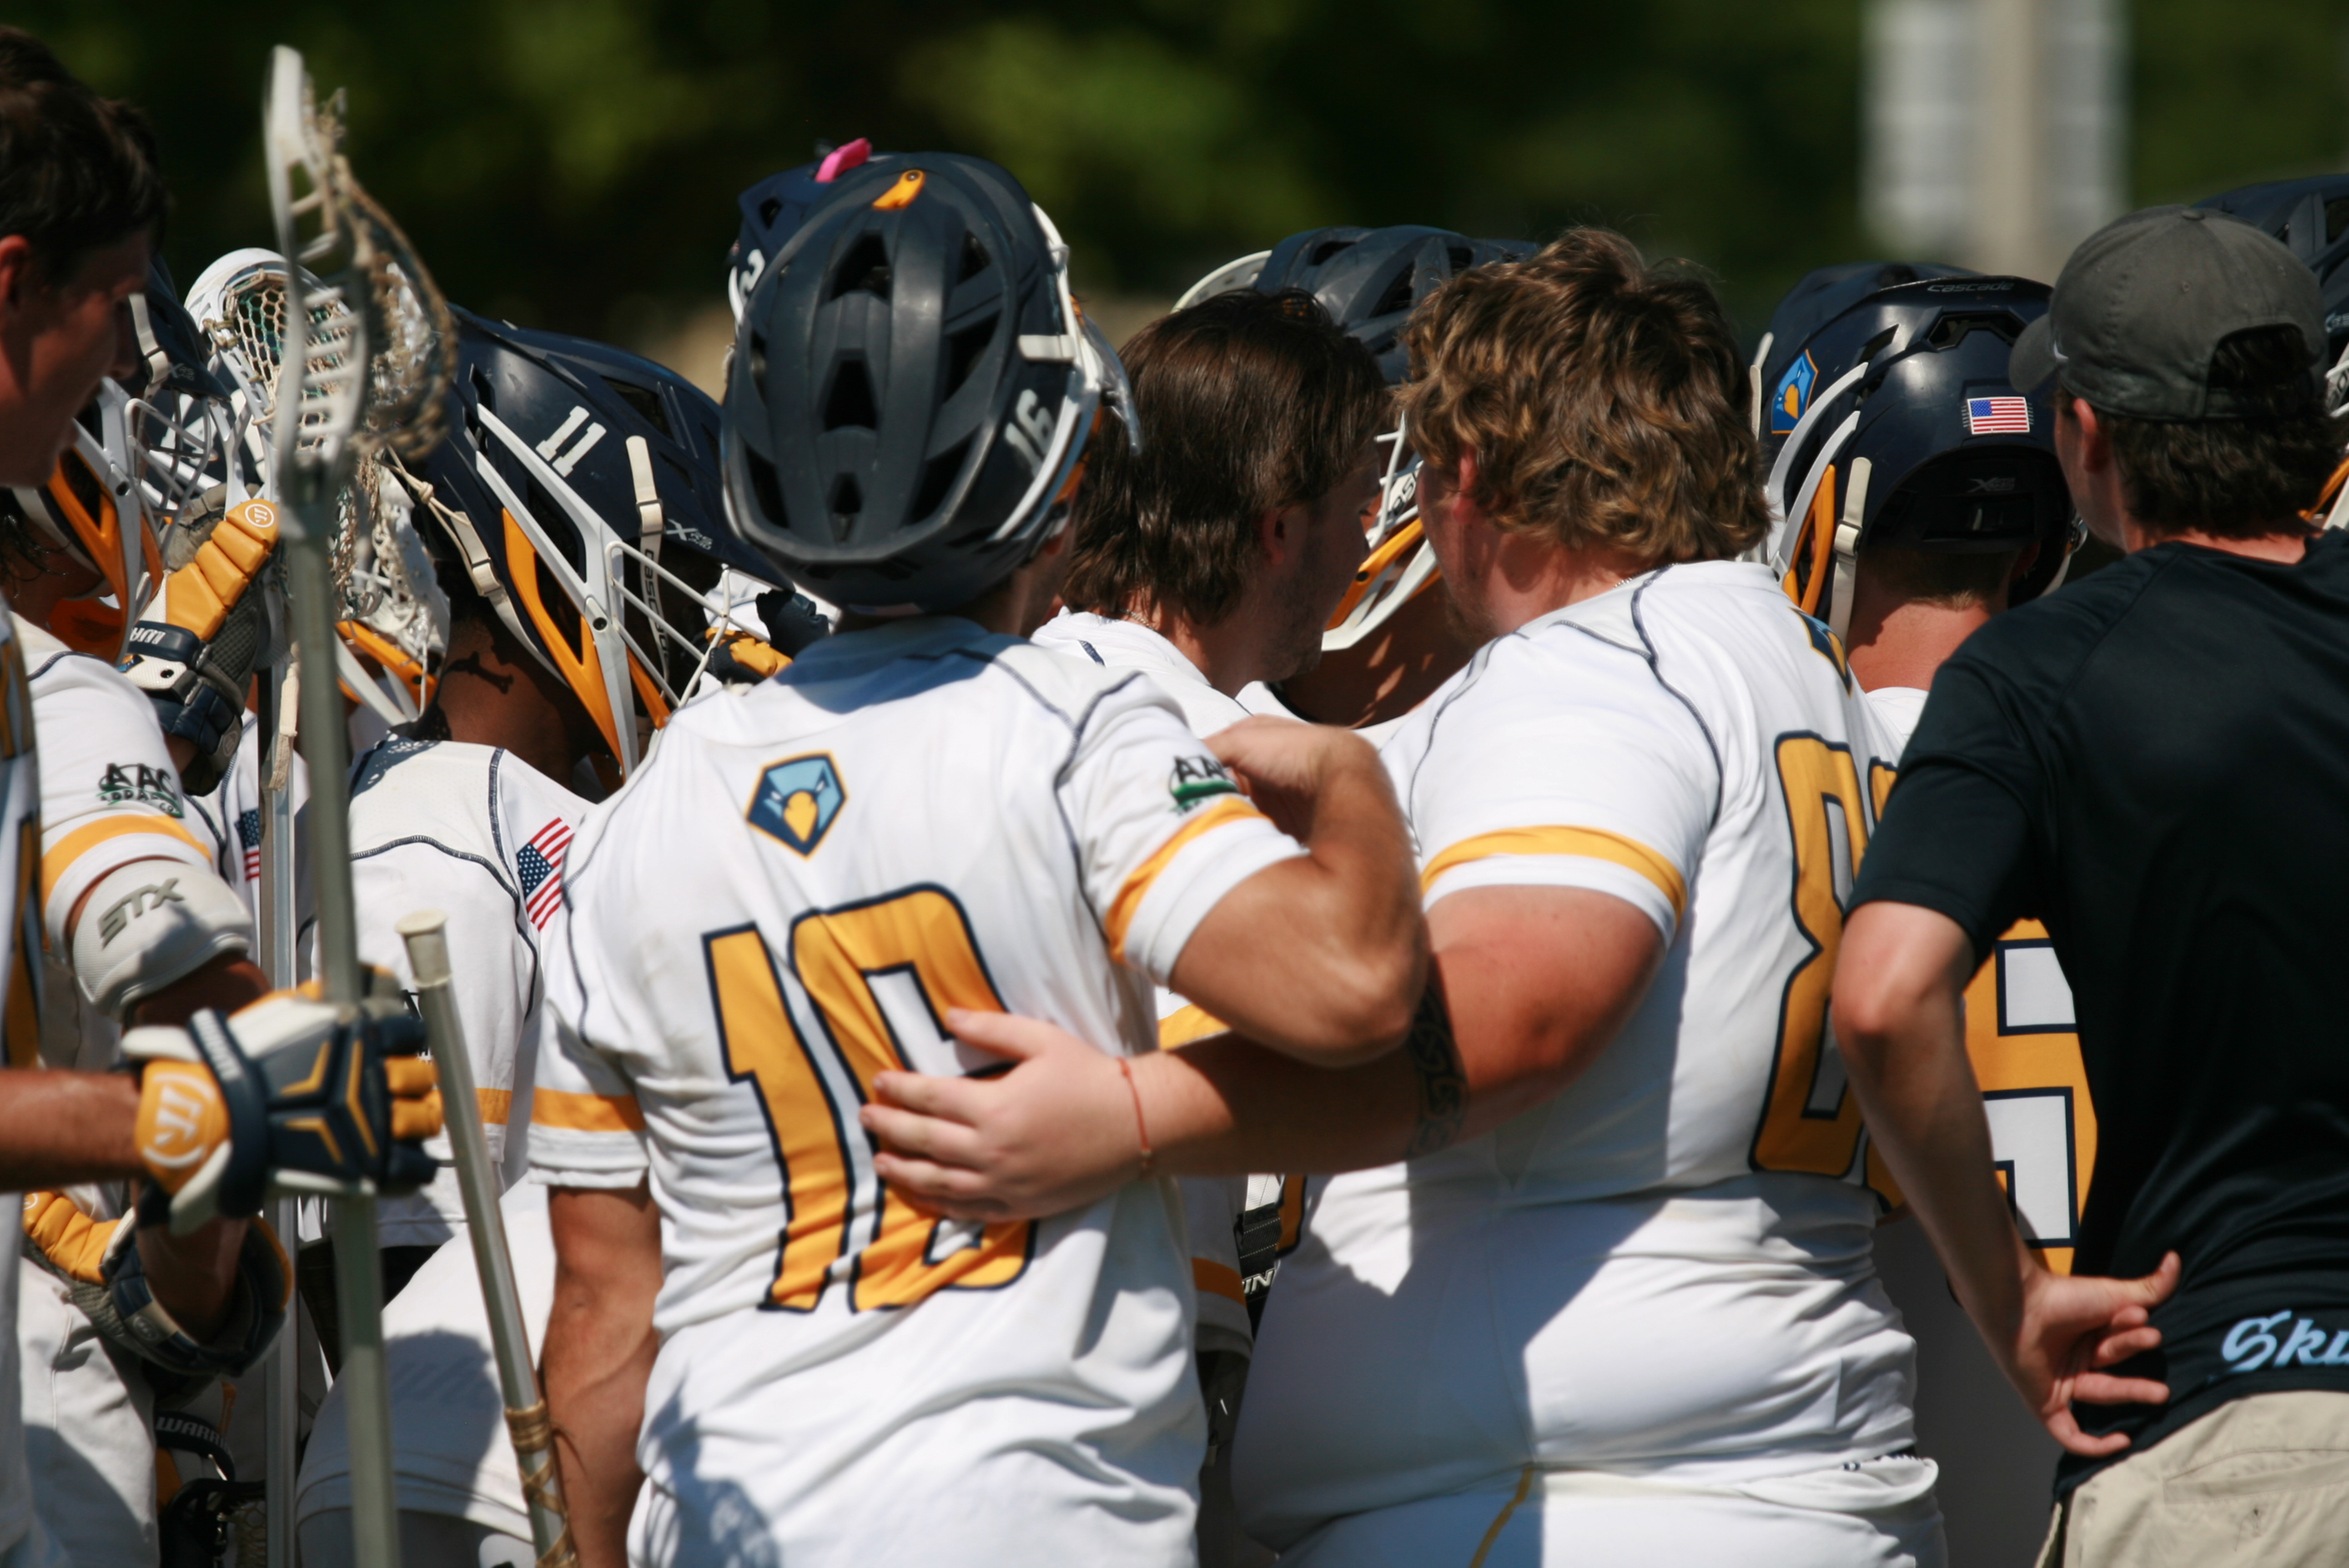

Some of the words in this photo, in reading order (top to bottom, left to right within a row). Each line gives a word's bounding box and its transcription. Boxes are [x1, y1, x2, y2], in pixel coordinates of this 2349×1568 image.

[535, 405, 607, 478] 11
[1173, 754, 1226, 784] AA
[97, 877, 185, 950] STX
